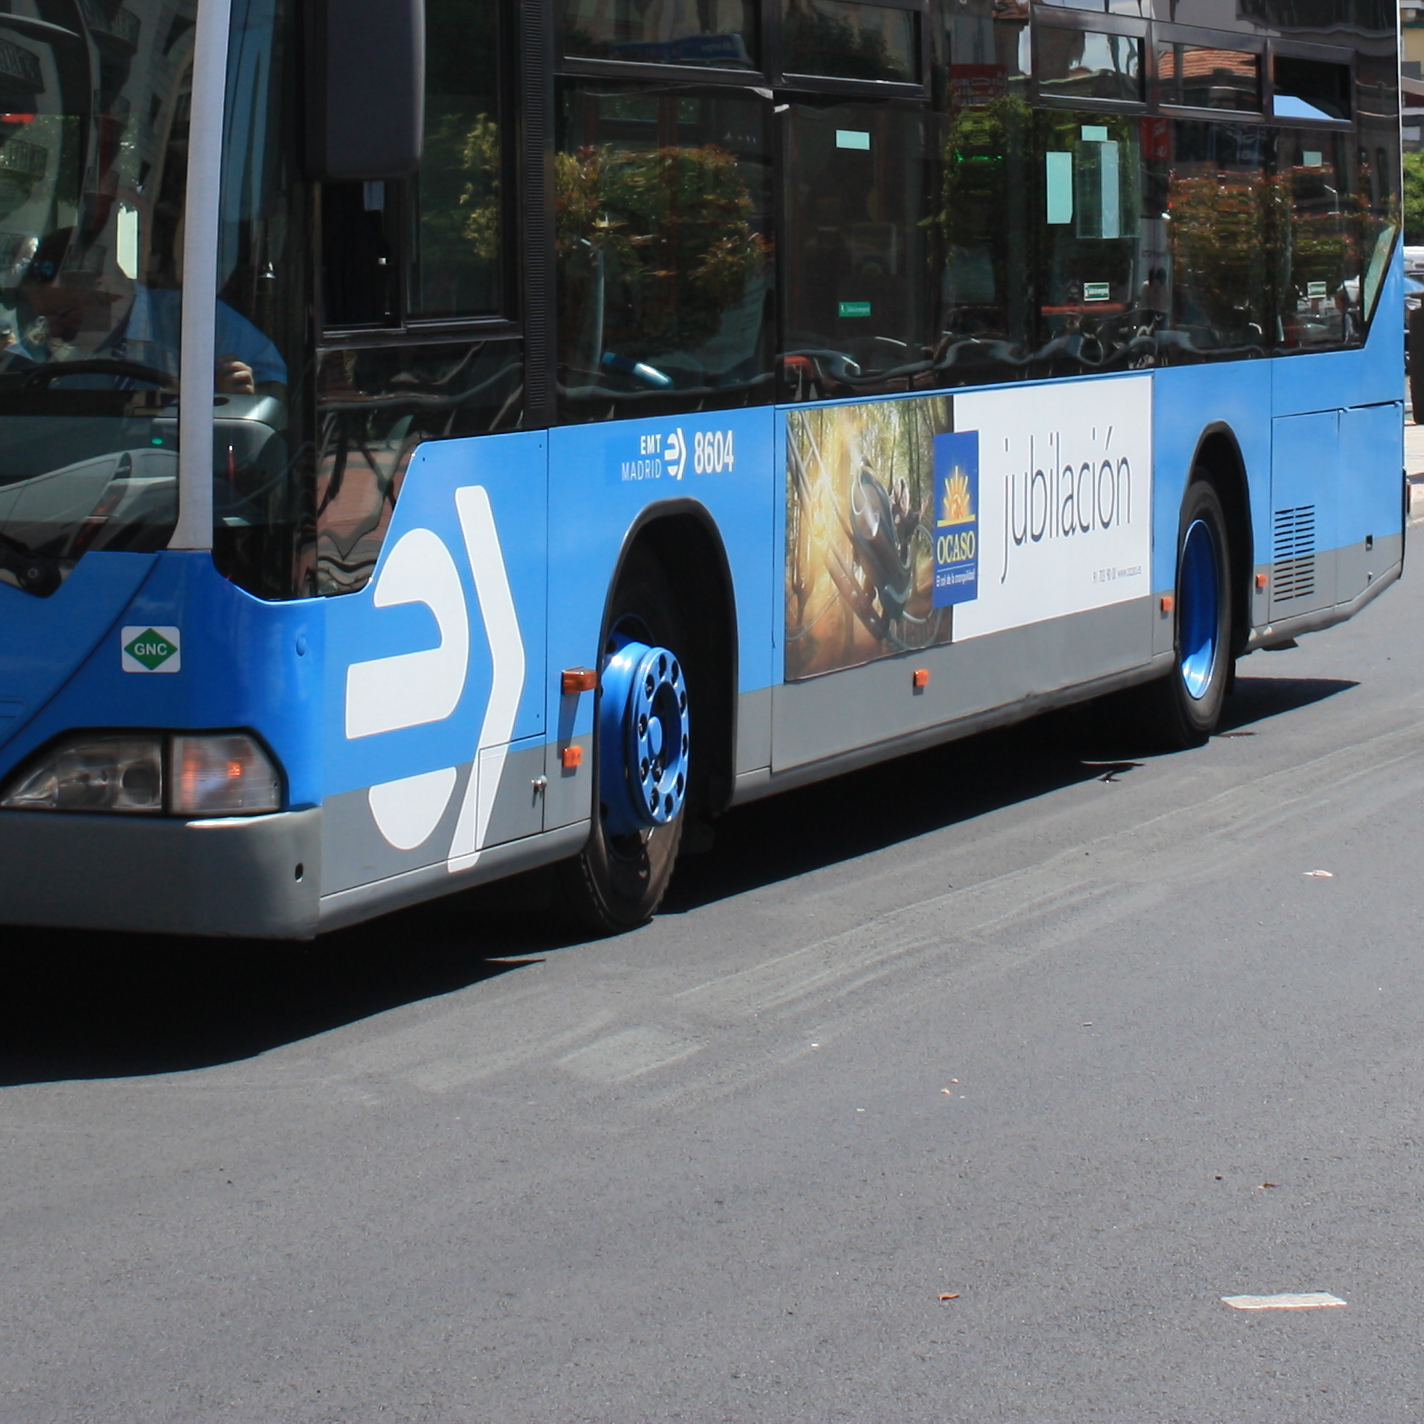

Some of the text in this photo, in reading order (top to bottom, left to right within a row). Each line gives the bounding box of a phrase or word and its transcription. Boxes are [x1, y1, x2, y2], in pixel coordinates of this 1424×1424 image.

[640, 433, 662, 455] EMT
[693, 429, 735, 475] 8604
[621, 458, 662, 482] MADRID
[1000, 425, 1132, 585] jubilación
[936, 530, 975, 565] OCASO
[134, 642, 168, 656] GNC
